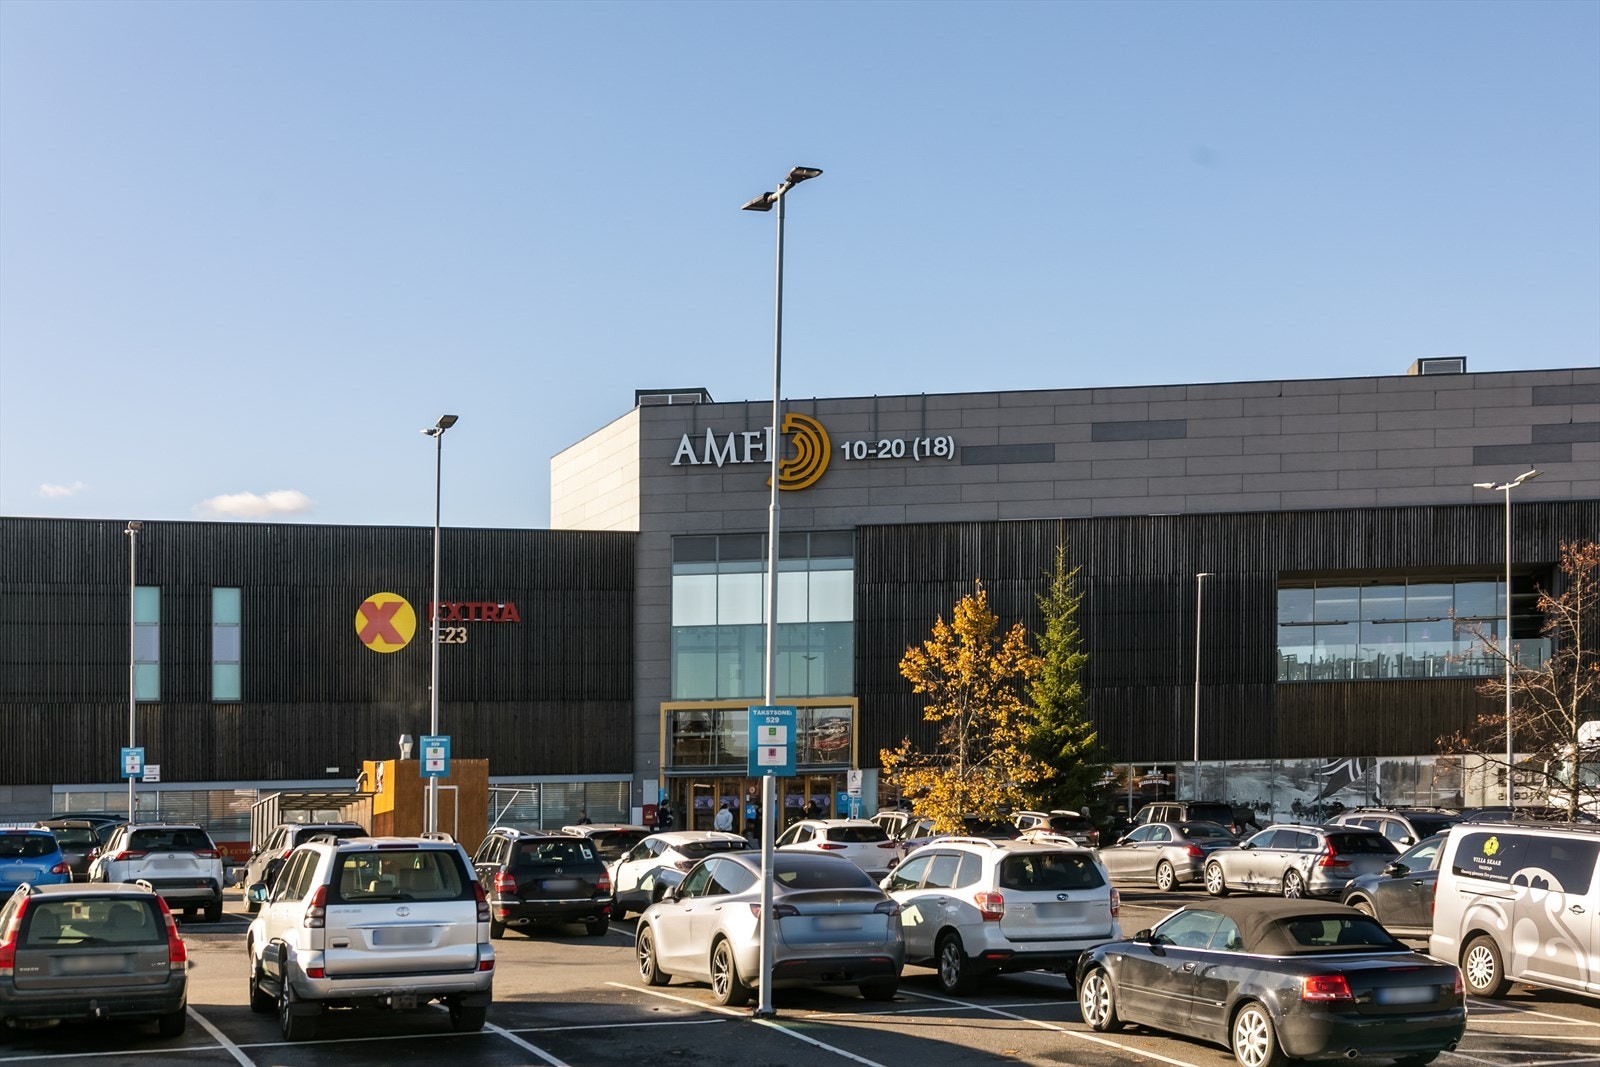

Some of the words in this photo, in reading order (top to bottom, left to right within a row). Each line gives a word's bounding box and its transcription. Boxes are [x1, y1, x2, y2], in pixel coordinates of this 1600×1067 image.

[670, 426, 774, 468] AMFI
[840, 438, 906, 460] 10-20
[913, 435, 955, 461] (18)
[427, 601, 522, 623] EXTRA
